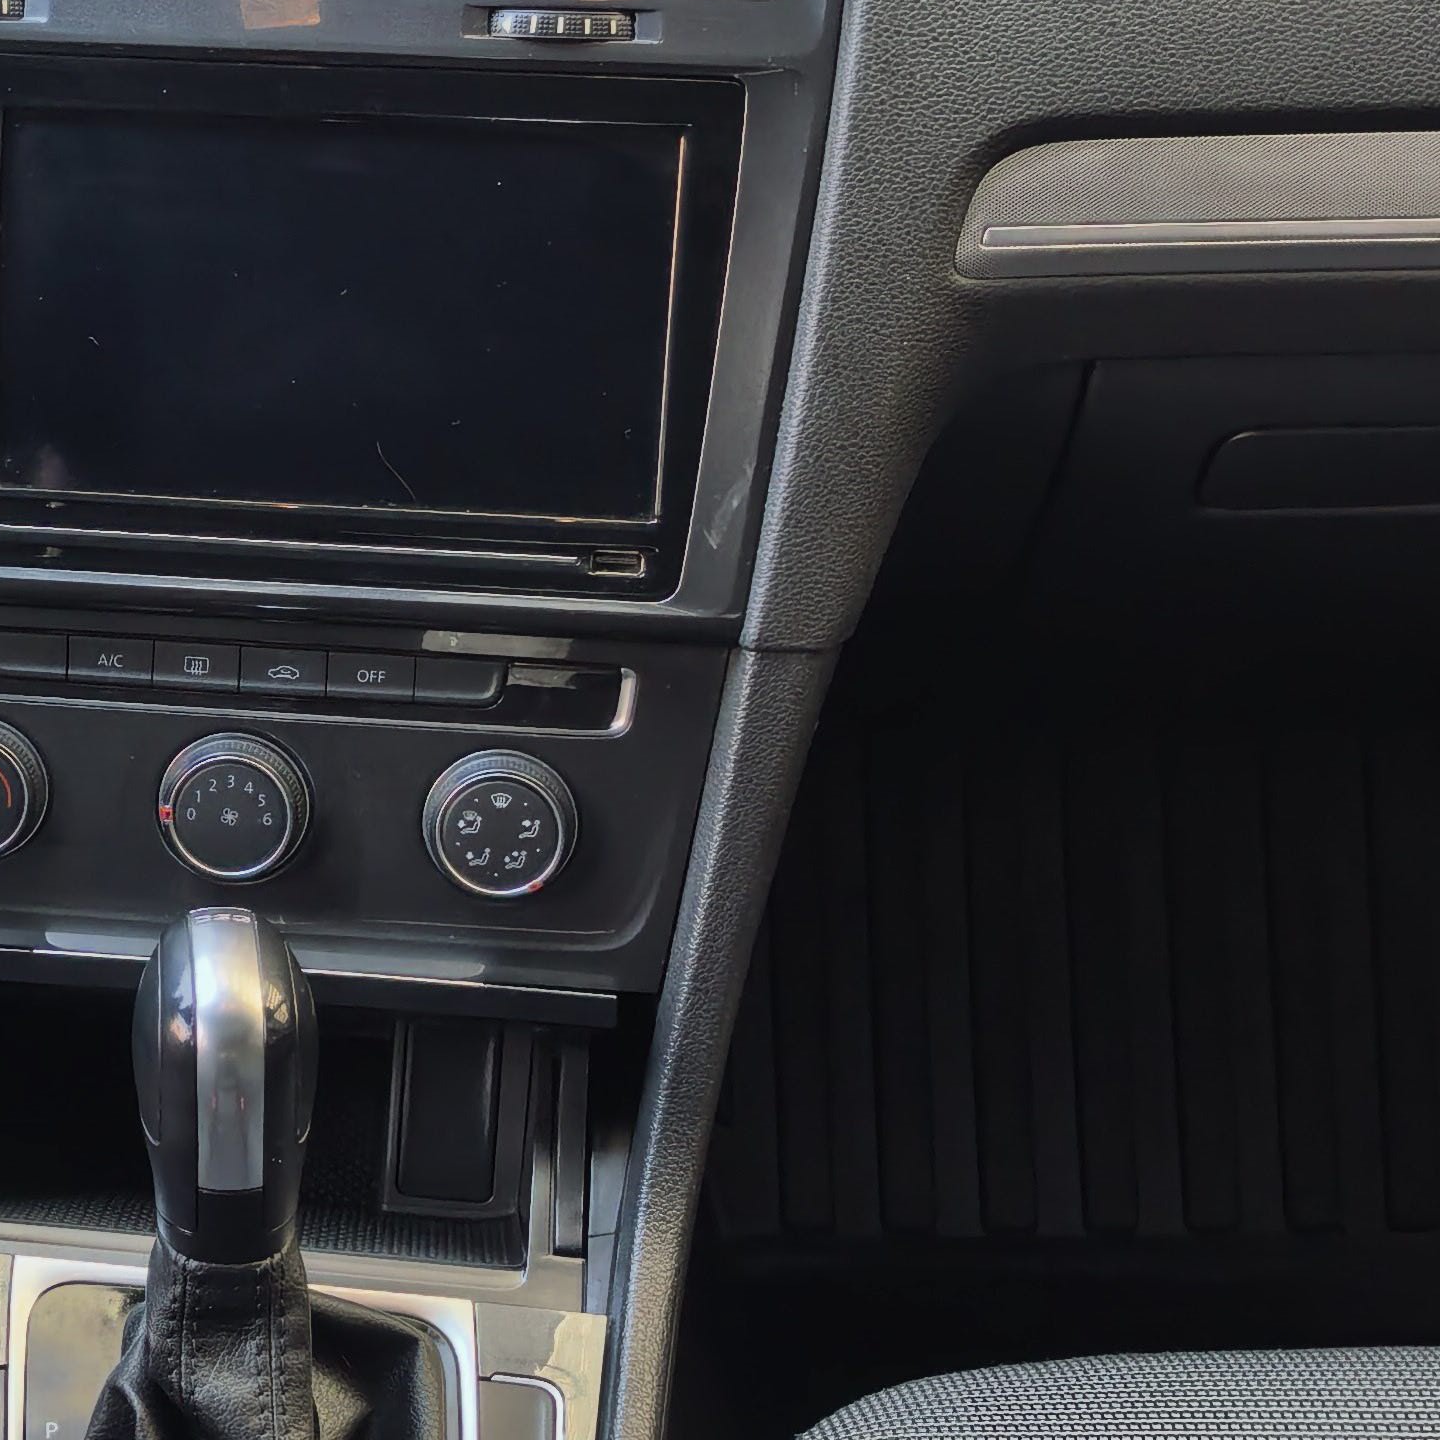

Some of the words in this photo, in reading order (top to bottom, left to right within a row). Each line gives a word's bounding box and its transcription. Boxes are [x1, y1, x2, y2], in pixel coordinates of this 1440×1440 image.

[97, 653, 124, 668] A/C
[356, 670, 387, 684] OFF
[208, 778, 217, 792] 2
[227, 774, 235, 788] 3
[243, 781, 254, 794] 4
[194, 789, 201, 803] 1
[258, 793, 266, 807] 5
[262, 812, 273, 826] 6
[45, 1421, 59, 1440] P
